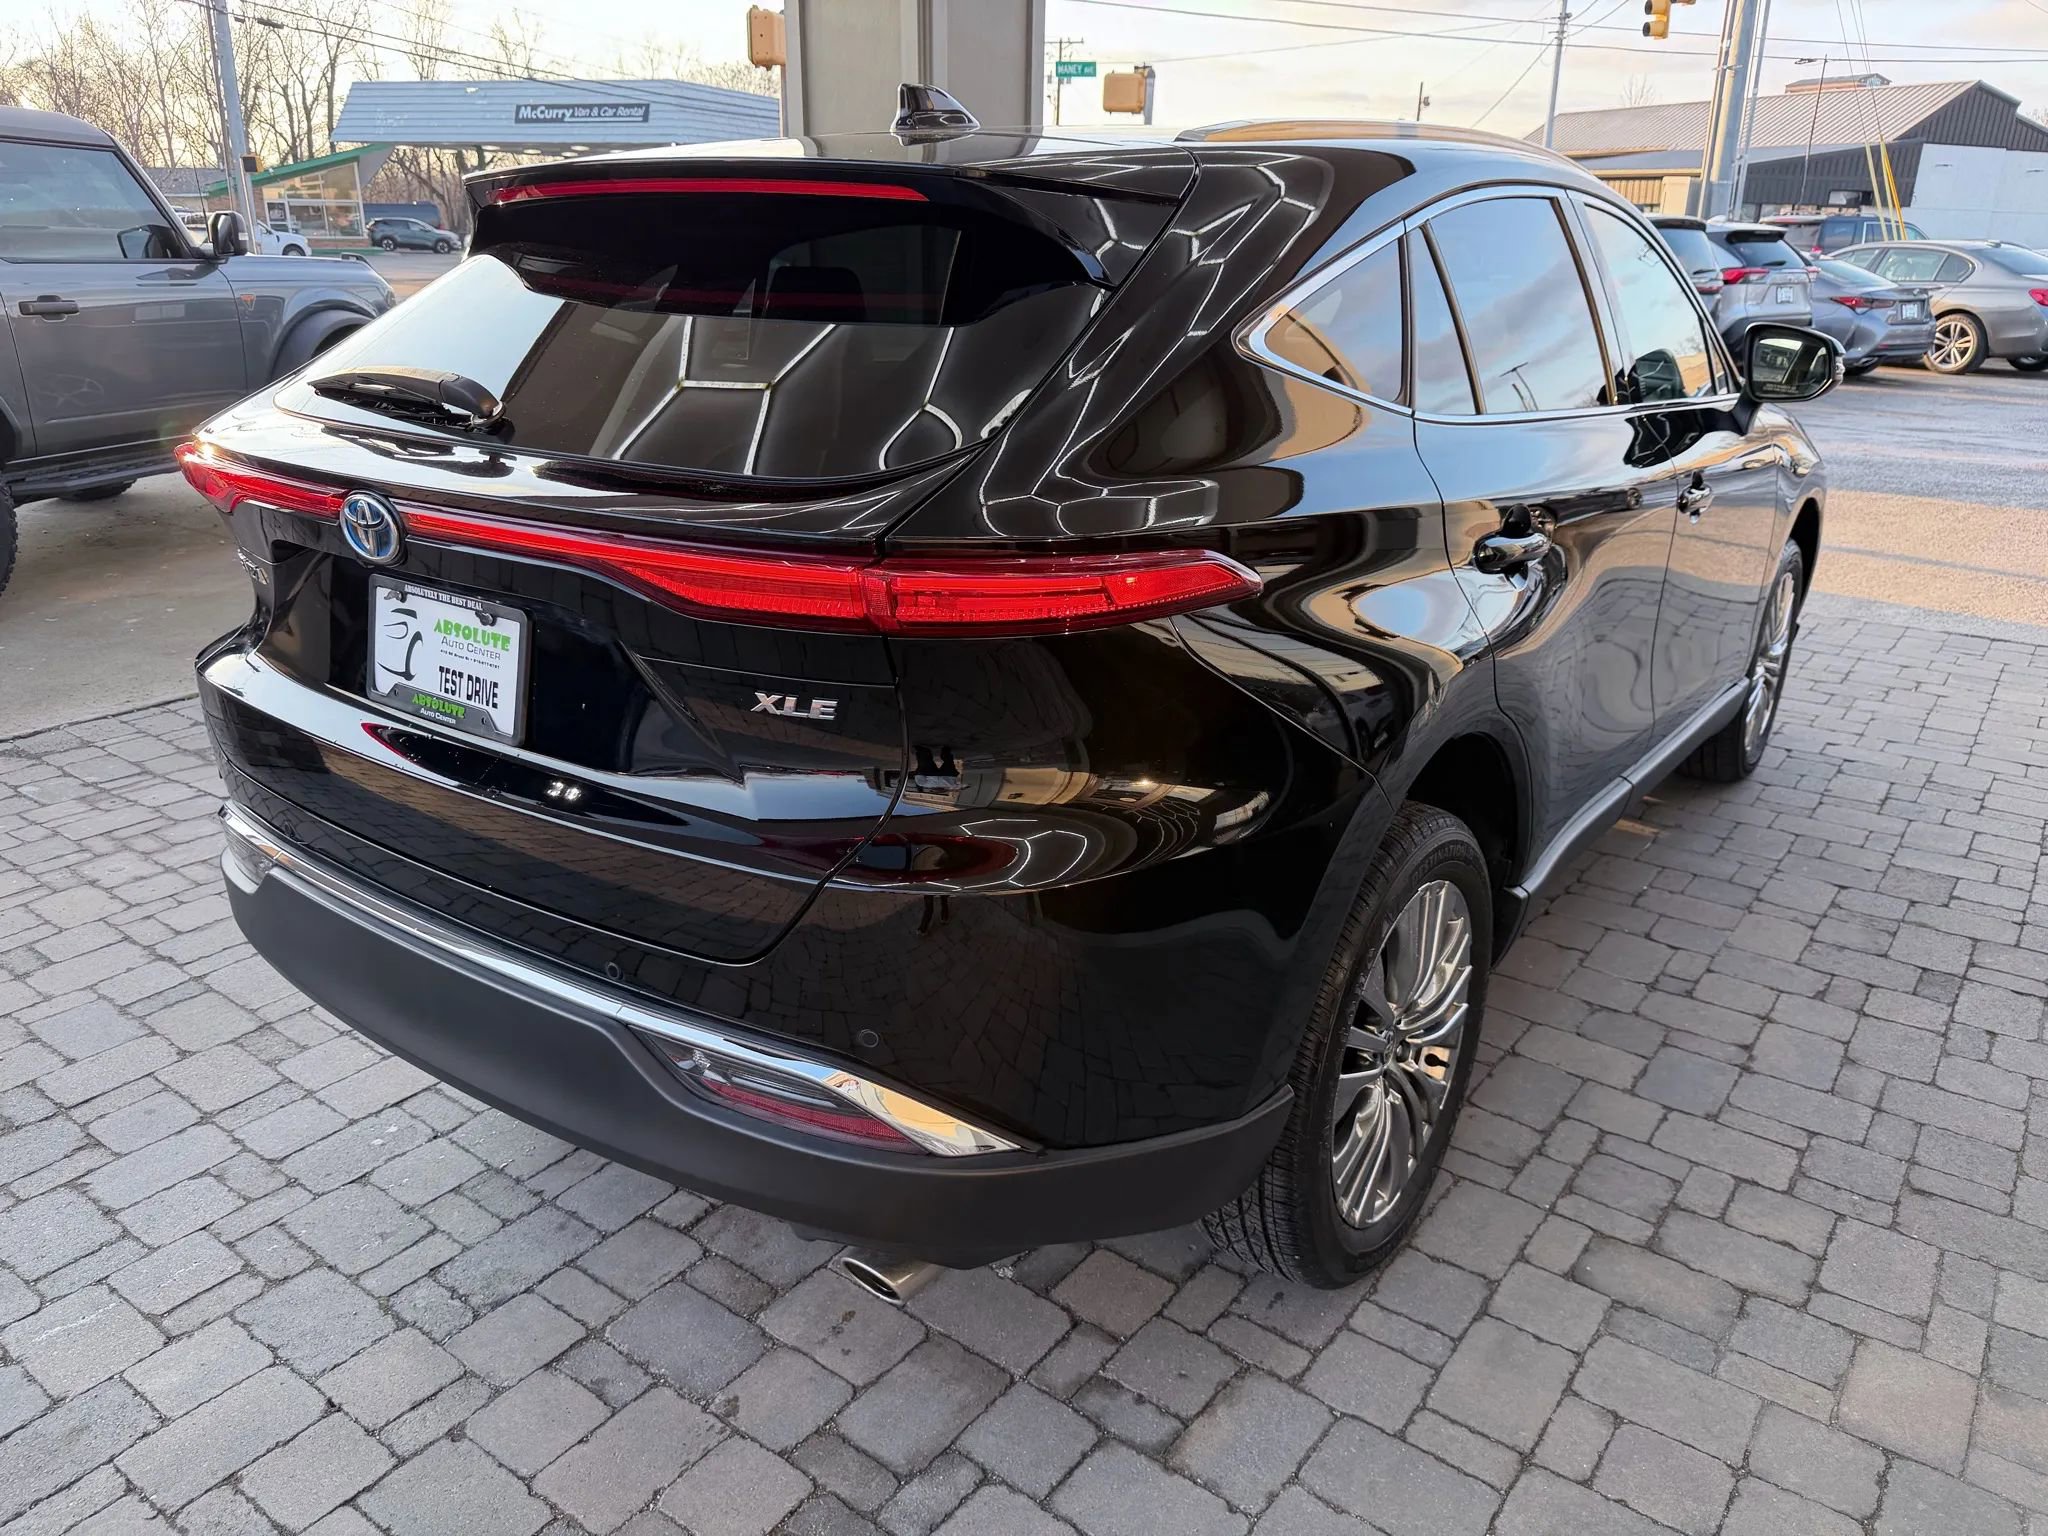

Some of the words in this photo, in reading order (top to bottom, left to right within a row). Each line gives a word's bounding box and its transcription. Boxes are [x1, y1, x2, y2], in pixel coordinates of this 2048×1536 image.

[1057, 63, 1082, 74] MANEY
[518, 106, 573, 120] McCurry
[574, 106, 590, 117] Van
[591, 106, 599, 117] &
[600, 106, 616, 117] Car
[617, 106, 645, 117] Rental
[404, 584, 438, 599] ABSOLUTELY
[438, 593, 451, 603] THE
[451, 596, 467, 607] BEST
[467, 600, 483, 611] DEAL
[434, 619, 511, 651] ABSOLUTE
[438, 665, 463, 696] TEST
[466, 675, 499, 709] DRIVE
[412, 694, 465, 717] ABSOLUTE
[750, 691, 838, 721] XLE
